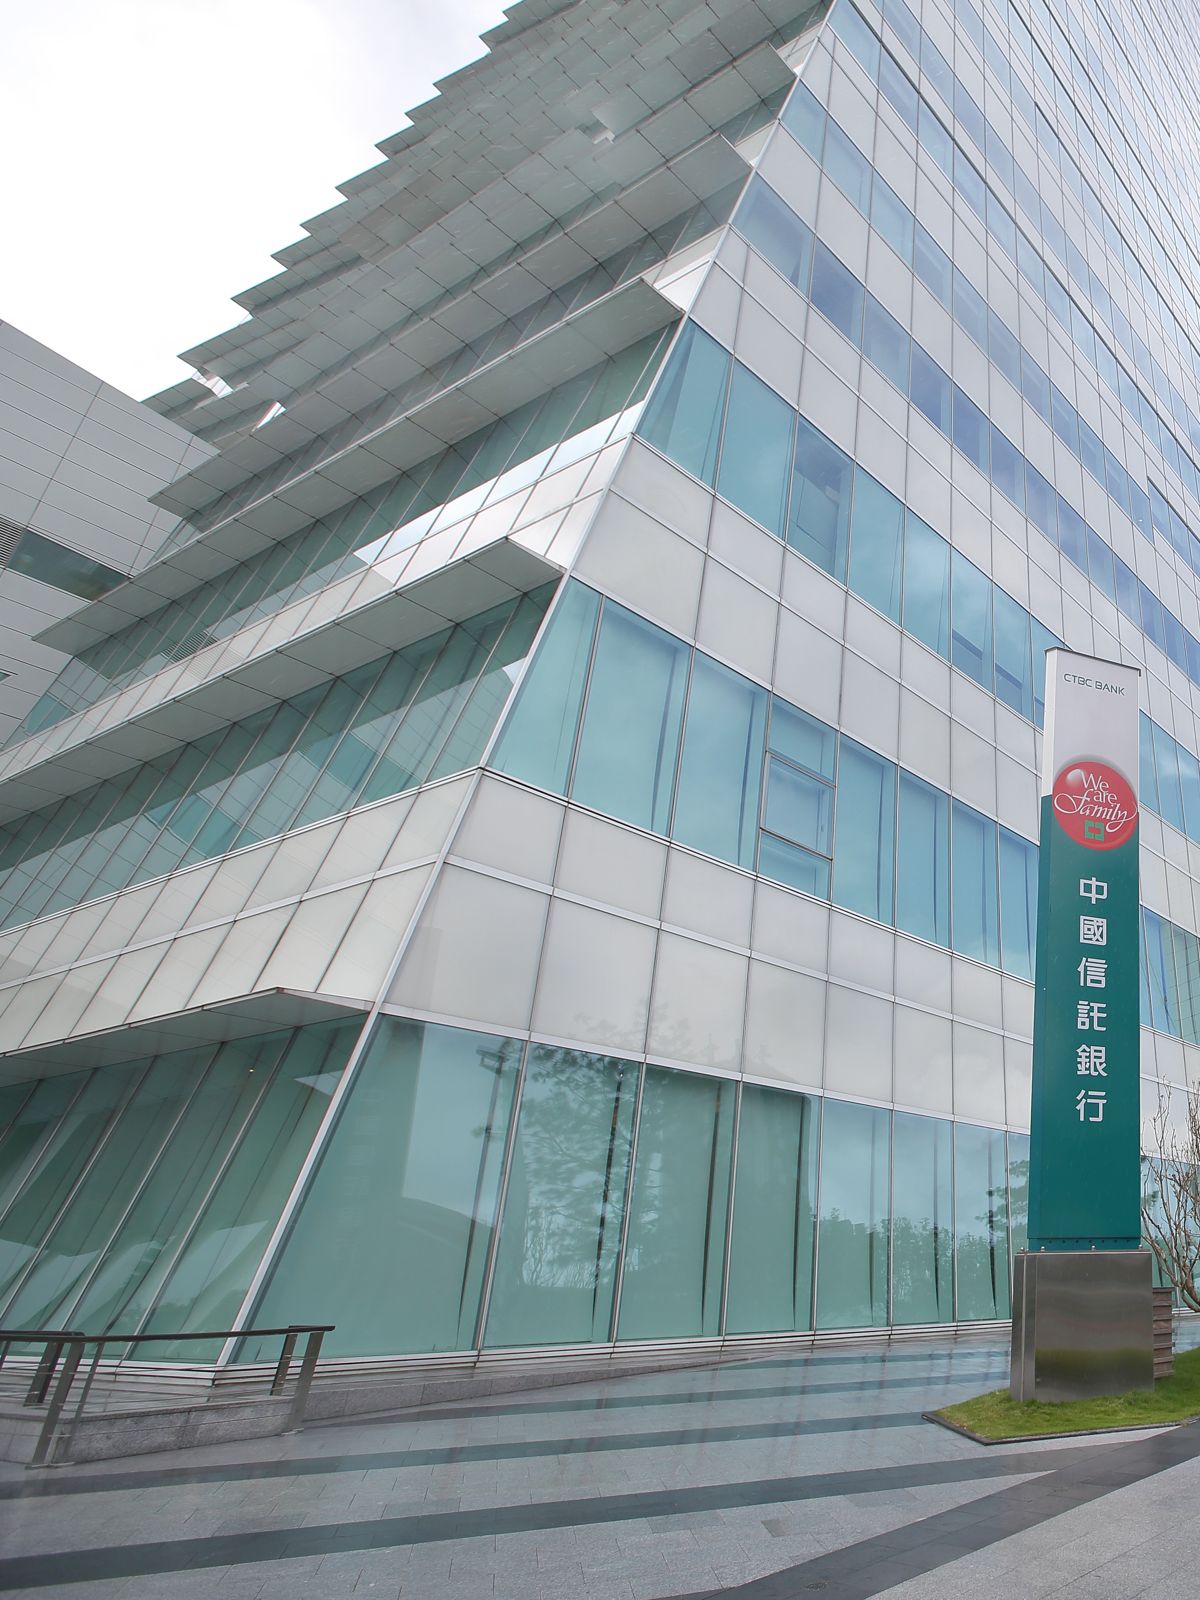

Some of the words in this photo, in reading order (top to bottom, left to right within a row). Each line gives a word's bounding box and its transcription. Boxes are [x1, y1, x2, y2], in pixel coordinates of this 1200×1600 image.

[1064, 673, 1093, 688] CTBC
[1095, 681, 1125, 696] BANK
[1068, 769, 1109, 792] We
[1093, 790, 1117, 805] are
[1076, 877, 1108, 1122] 中國信託銀行
